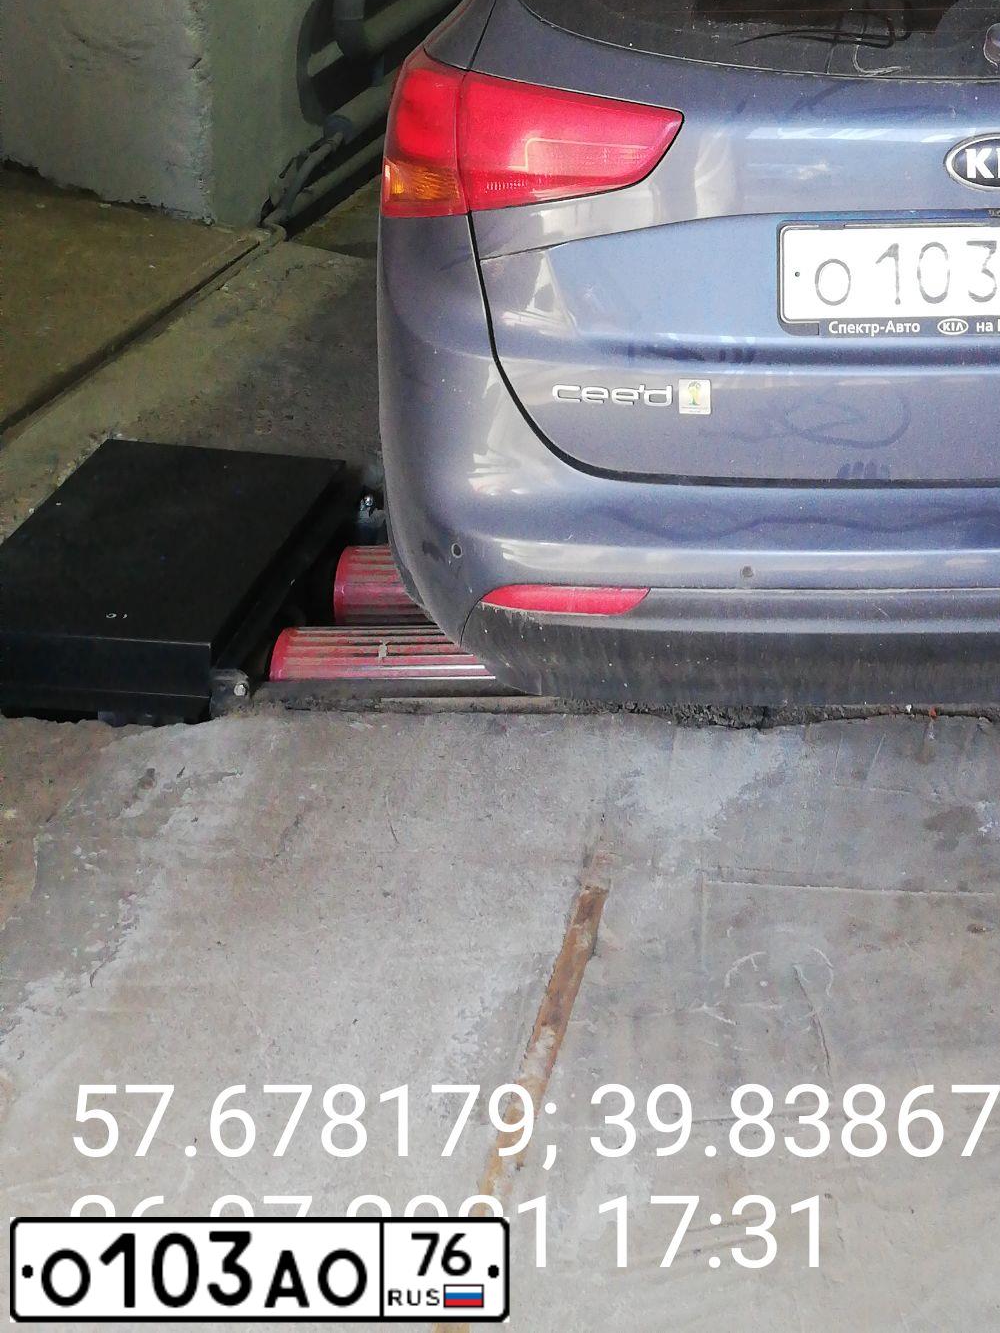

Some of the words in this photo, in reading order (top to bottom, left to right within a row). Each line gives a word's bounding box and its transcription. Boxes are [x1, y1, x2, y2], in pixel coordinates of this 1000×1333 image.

[828, 320, 920, 337] Спектр-Авто
[941, 321, 966, 332] KIA
[976, 322, 994, 333] на
[552, 384, 673, 407] cee'd
